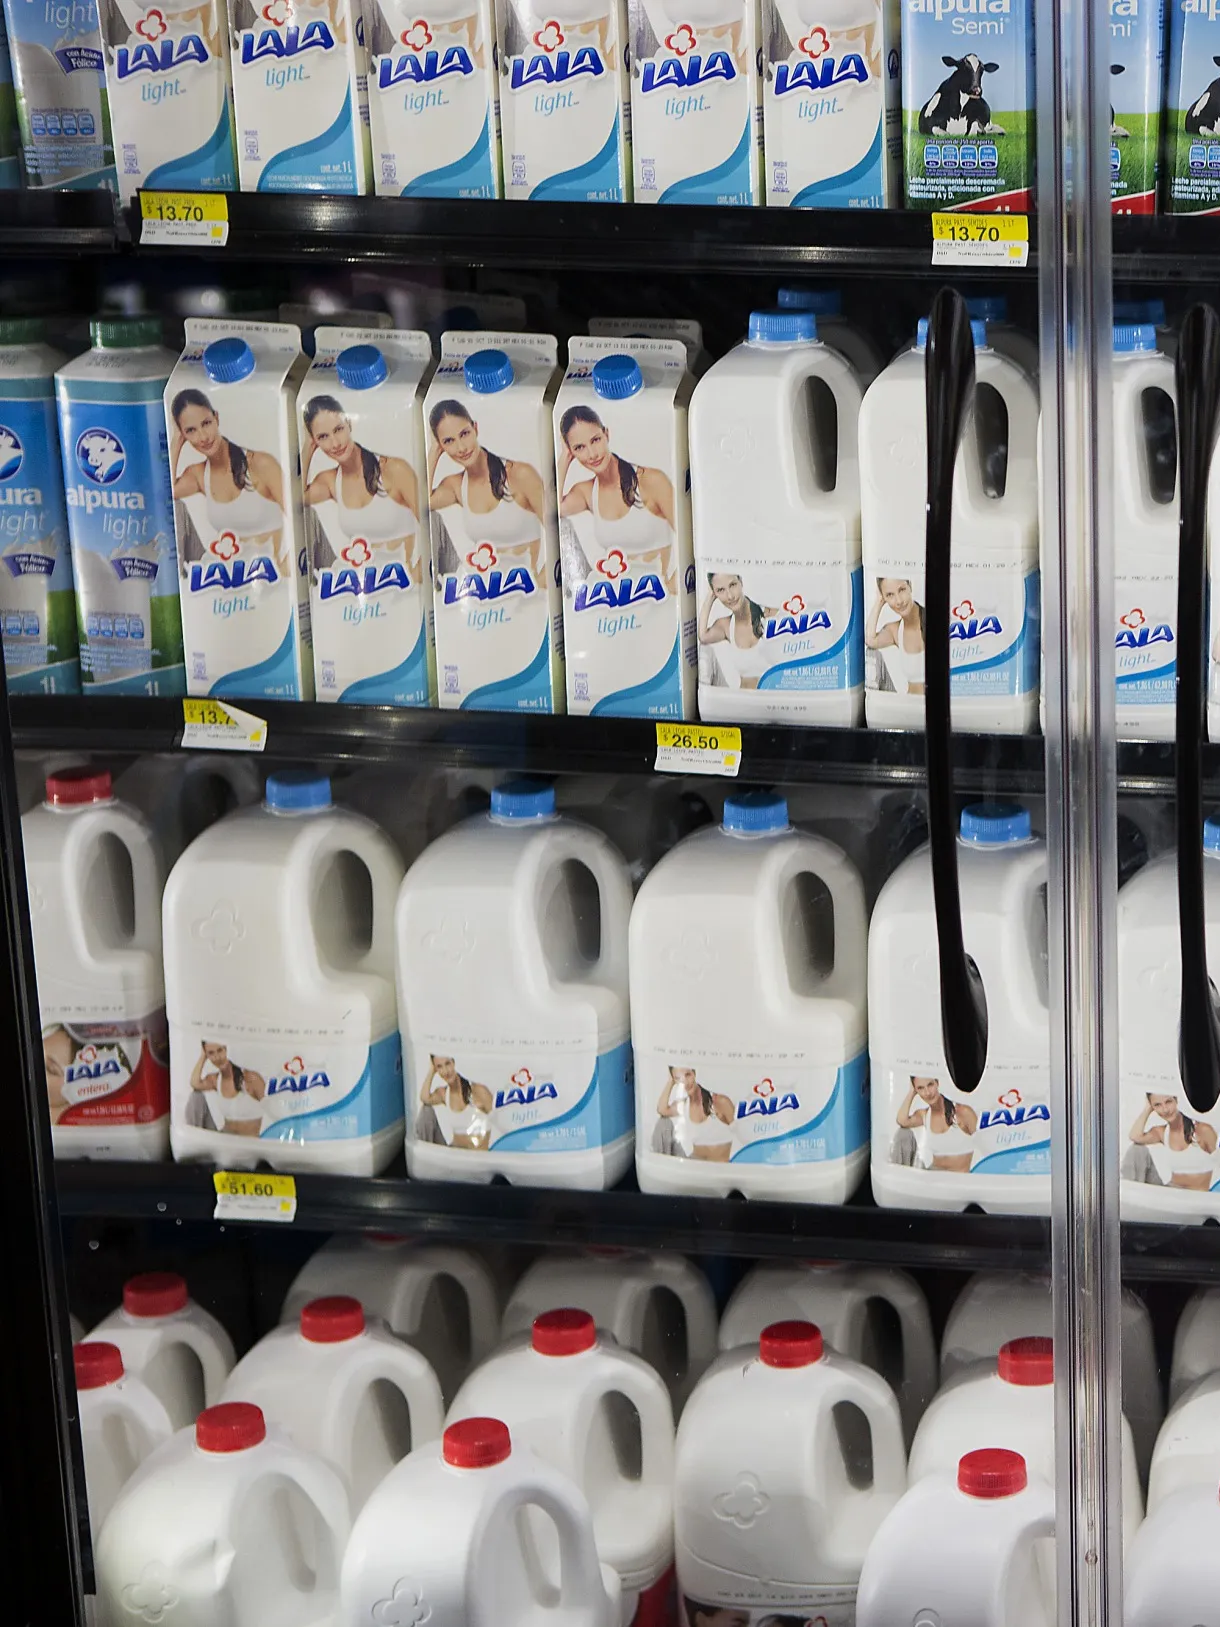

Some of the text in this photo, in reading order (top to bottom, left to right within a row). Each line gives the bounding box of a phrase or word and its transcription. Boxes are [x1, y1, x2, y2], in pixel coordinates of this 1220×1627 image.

[45, 0, 94, 27] light
[909, 0, 1010, 20] alpura
[952, 18, 1003, 35] Semi
[243, 22, 334, 64] LALA
[118, 36, 208, 78] LALA
[380, 47, 473, 88] LALA
[512, 48, 603, 88] LALA
[265, 63, 304, 87] light
[642, 52, 736, 92] LALA
[775, 55, 868, 94] LALA
[142, 79, 180, 105] light
[404, 89, 445, 115] light
[534, 90, 574, 115] light
[665, 95, 706, 120] light
[797, 96, 838, 120] light
[156, 206, 203, 221] 13.70
[949, 226, 999, 241] 13.70
[0, 487, 42, 505] ura
[67, 485, 144, 513] alpura
[1, 511, 45, 536] ight
[103, 514, 147, 539] light
[191, 559, 277, 591] LALA
[321, 564, 409, 599] LALA
[445, 568, 534, 604] LALA
[575, 575, 665, 610] LALA
[214, 597, 250, 617] light
[343, 602, 381, 624] light
[468, 607, 505, 628] light
[597, 613, 636, 636] light
[766, 612, 831, 638] LALA
[949, 615, 1003, 638] ALA
[783, 638, 812, 655] light
[1115, 625, 1174, 648] ALA
[951, 644, 980, 660] light
[1119, 652, 1153, 668] light
[198, 710, 239, 725] 13.7
[672, 734, 719, 750] 26.50
[67, 1060, 120, 1083] LALA
[269, 1073, 329, 1094] LALA
[496, 1084, 557, 1107] LALA
[738, 1095, 799, 1118] LALA
[511, 1109, 541, 1125] light
[753, 1120, 781, 1134] light
[980, 1106, 1050, 1128] LALA
[996, 1129, 1027, 1145] light
[229, 1183, 273, 1196] 51.60
